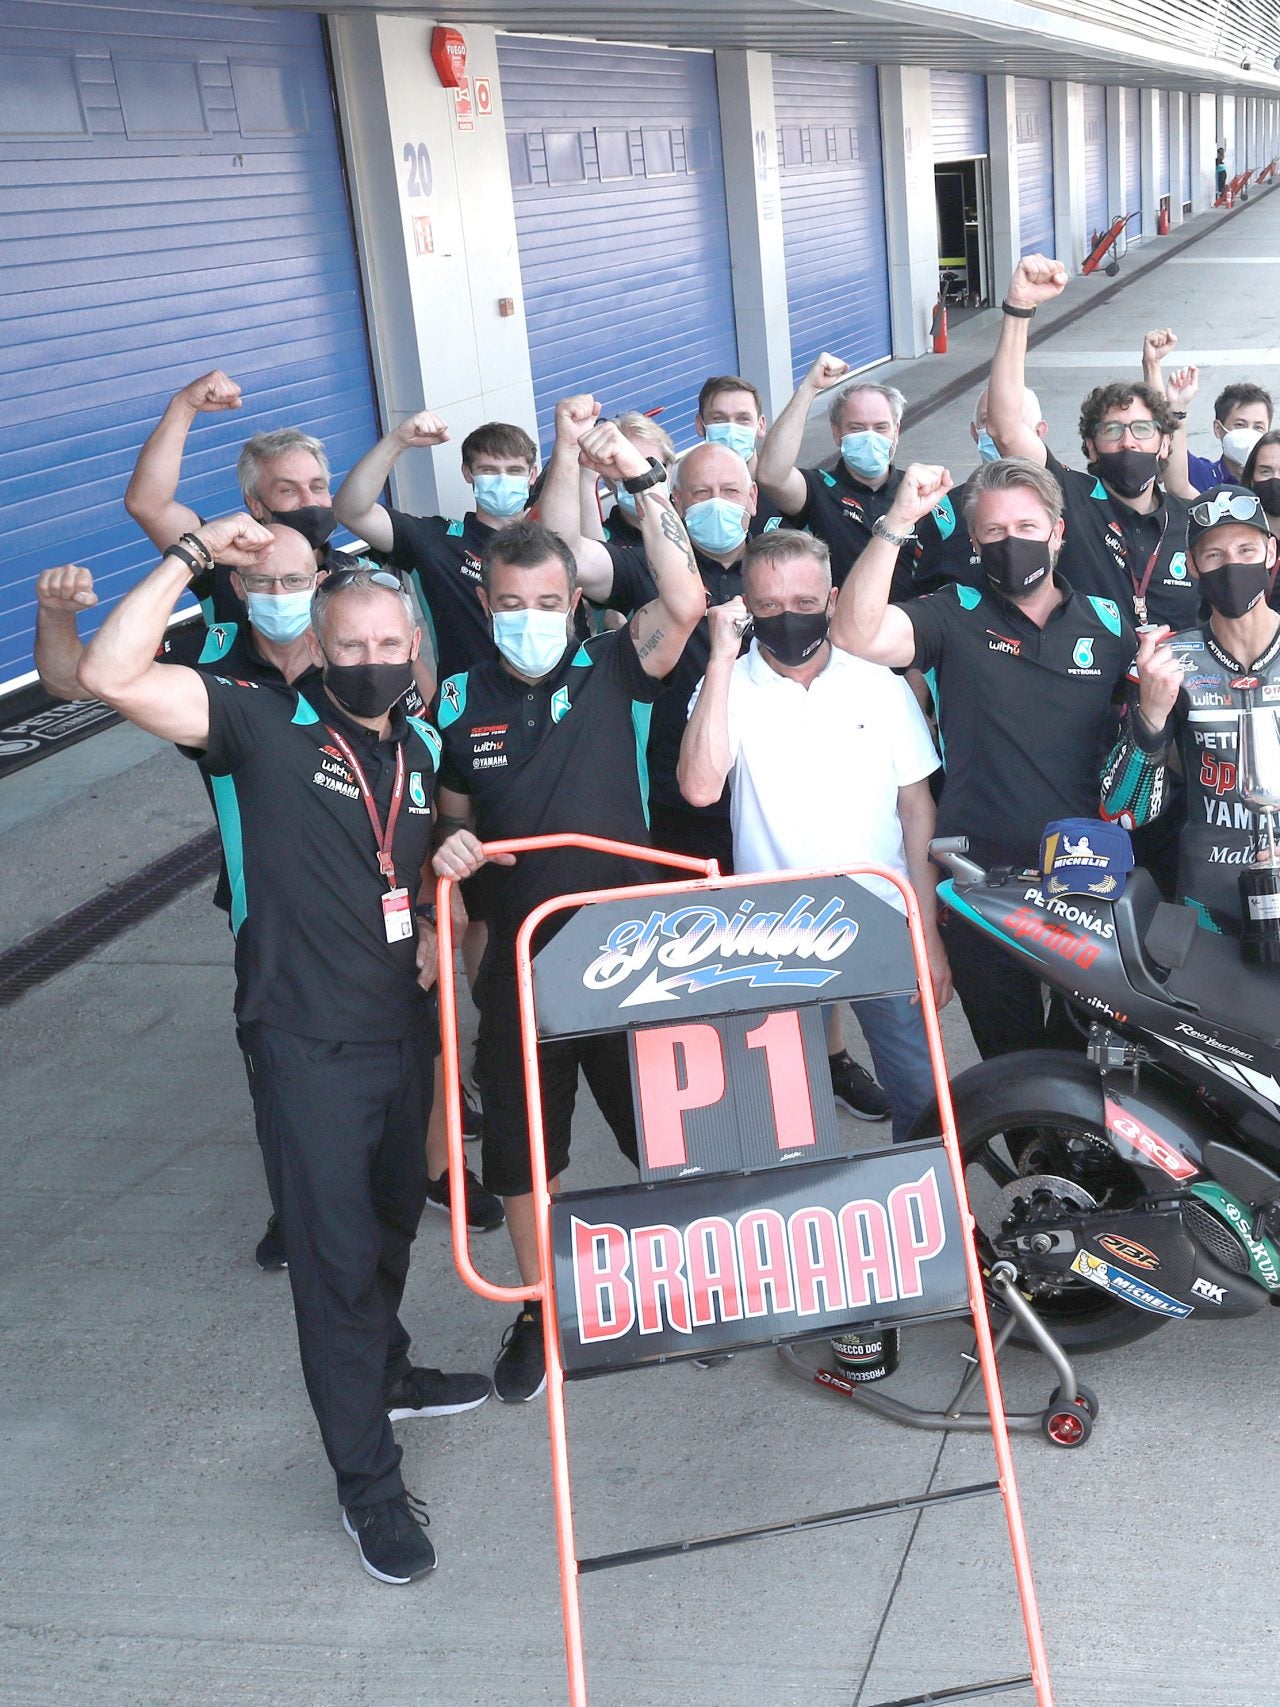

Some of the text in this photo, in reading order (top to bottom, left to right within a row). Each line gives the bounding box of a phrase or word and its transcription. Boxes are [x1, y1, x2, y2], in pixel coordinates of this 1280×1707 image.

[446, 45, 466, 55] FUEGO
[403, 142, 433, 197] 20
[1163, 579, 1192, 587] PETRONAS
[1207, 640, 1241, 672] PETRONAS
[1067, 668, 1102, 676] PETRONAS
[1193, 692, 1233, 706] withu
[473, 741, 504, 753] withu
[321, 759, 354, 784] withu
[480, 754, 508, 769] YAMAHA
[324, 776, 361, 800] YAMAHA
[1053, 857, 1111, 869] MICHELIN
[1023, 887, 1115, 940] PETRONAS
[582, 894, 860, 991] El Diablo
[1002, 906, 1103, 971] Sprinta
[1174, 1021, 1209, 1042] Revs
[1228, 1045, 1255, 1062] Heart
[1138, 1137, 1181, 1171] RCB
[570, 1166, 947, 1345] BRAAAAP
[1112, 1277, 1189, 1315] MICHELIN
[1191, 1277, 1228, 1301] RK
[865, 1341, 882, 1354] DOC
